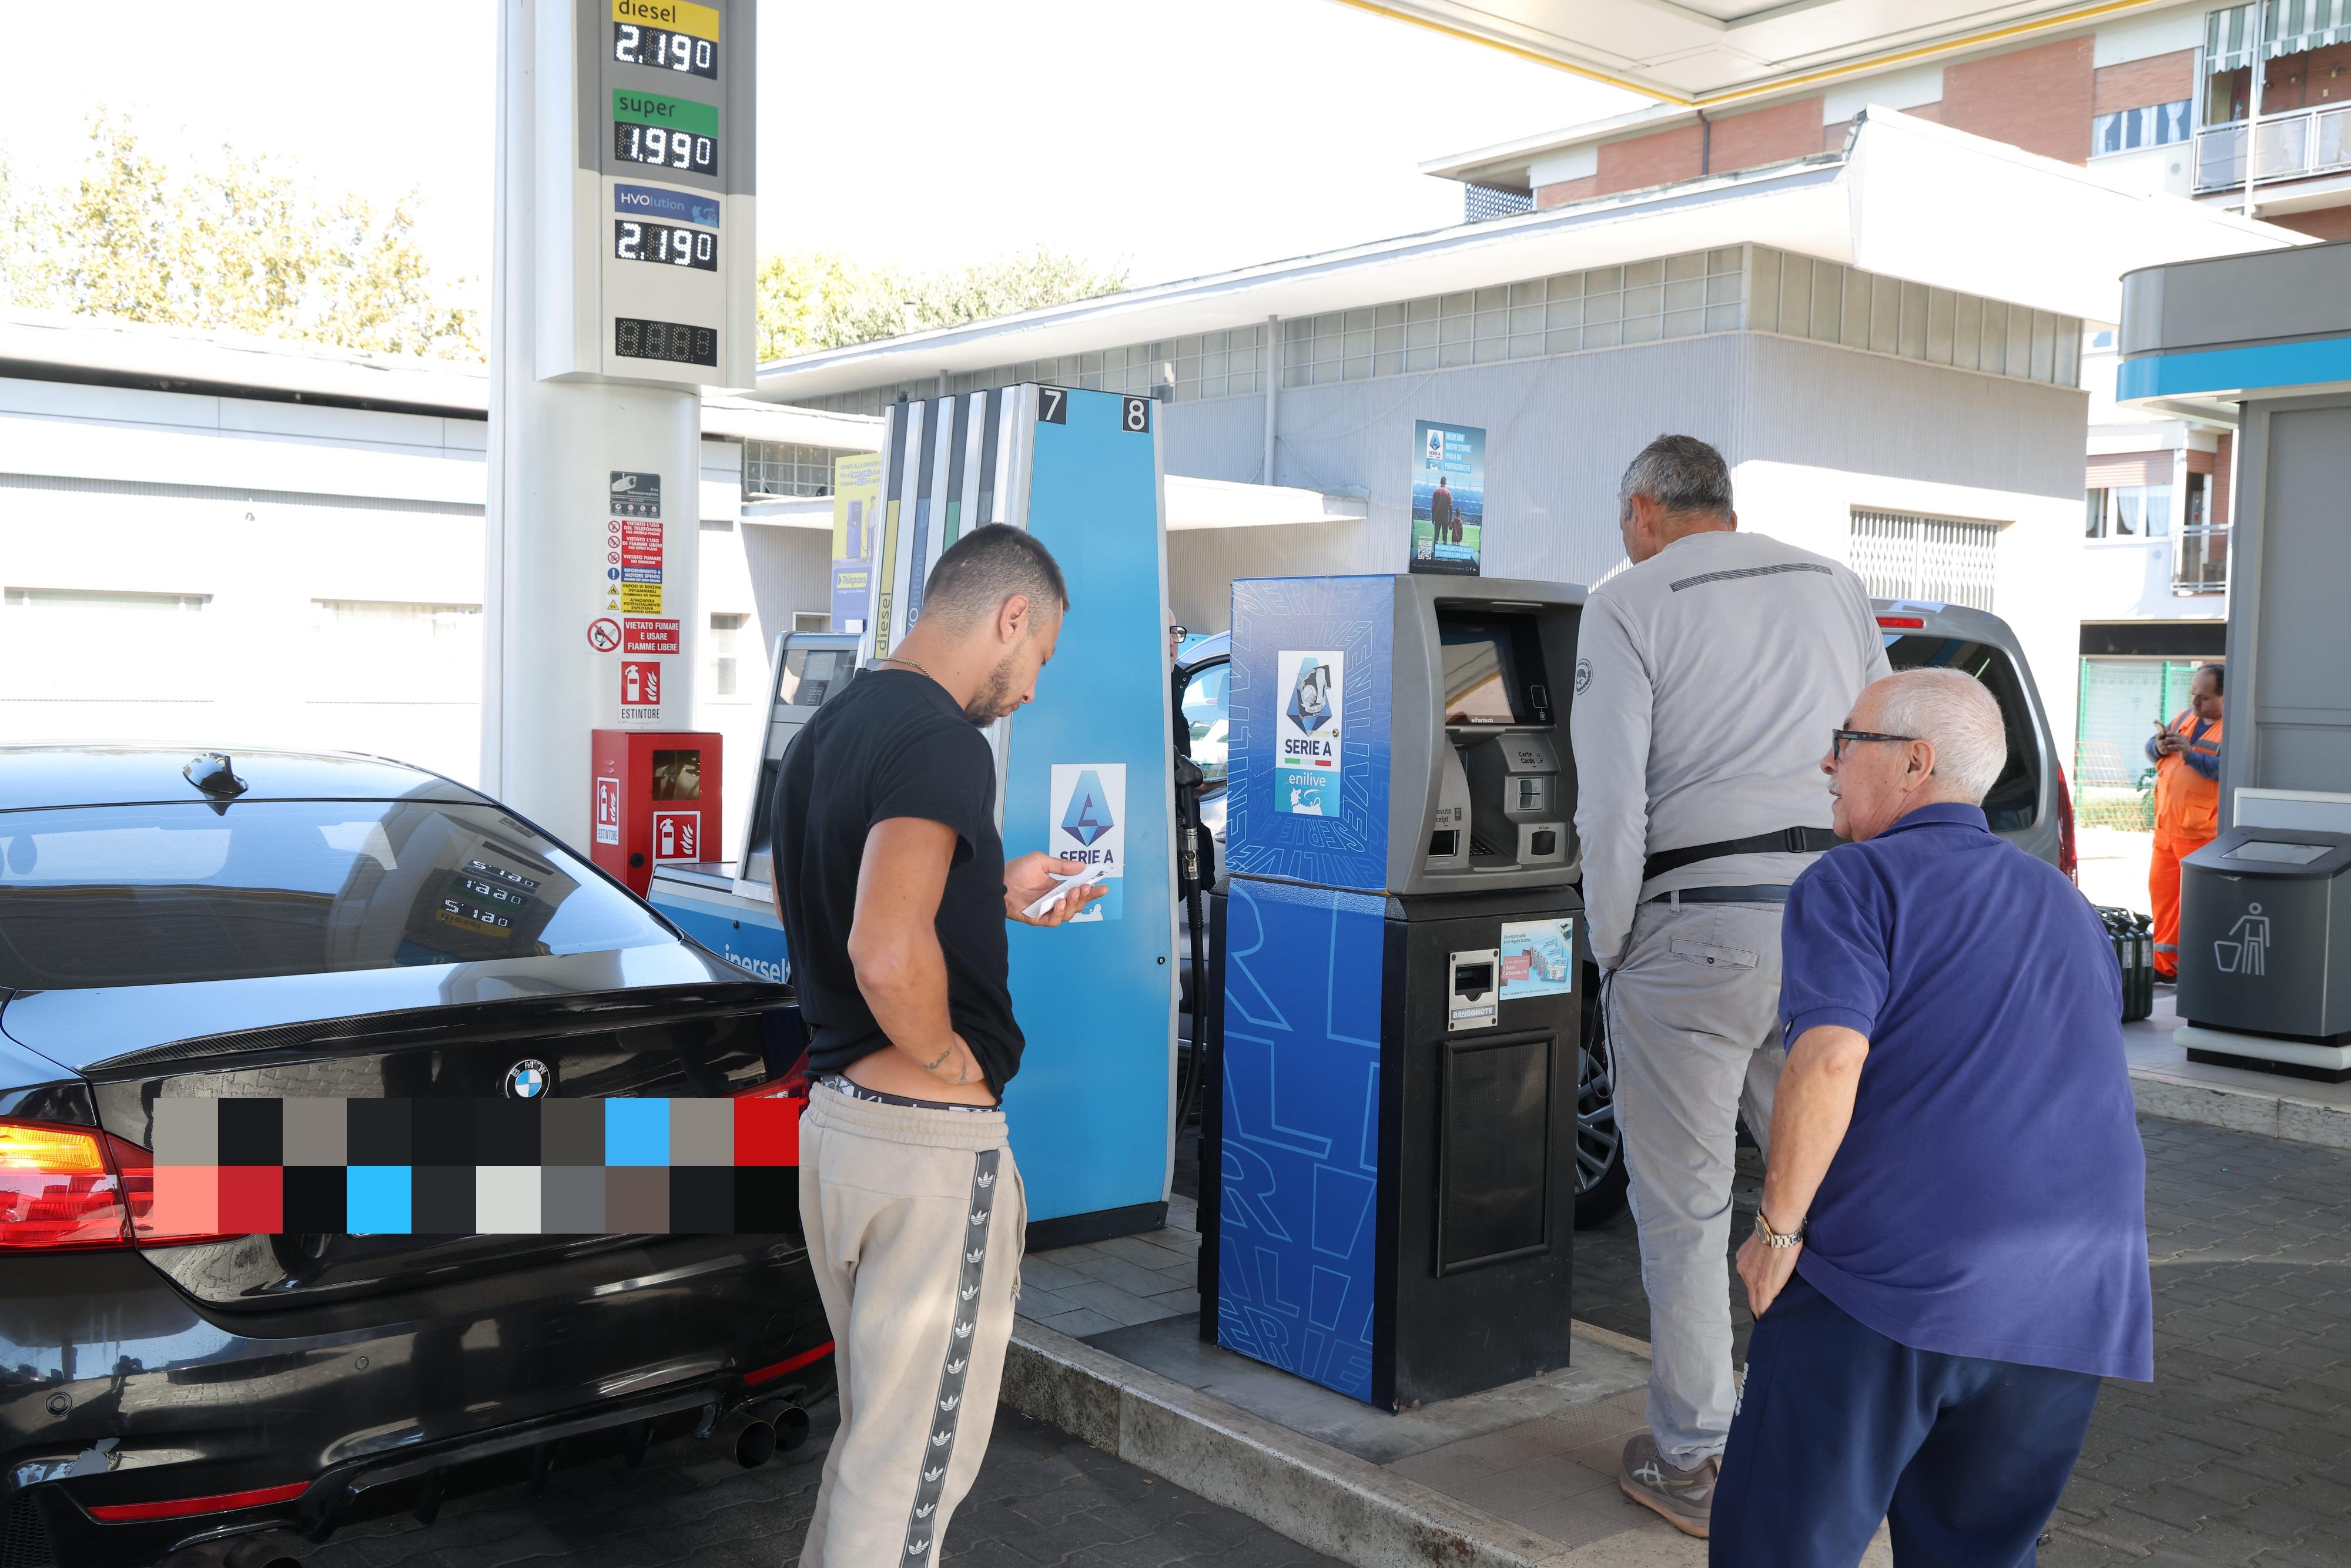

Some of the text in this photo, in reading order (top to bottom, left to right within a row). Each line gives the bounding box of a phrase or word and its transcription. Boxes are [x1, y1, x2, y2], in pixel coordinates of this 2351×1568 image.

[618, 0, 676, 23] diesel
[616, 25, 711, 72] 2.190
[619, 97, 675, 118] super
[631, 128, 711, 169] 1.990
[621, 193, 685, 211] HVOlution
[618, 223, 711, 266] 2.190
[1043, 390, 1062, 421] 7
[1127, 400, 1145, 430] 8
[843, 575, 866, 586] Telepass
[909, 554, 923, 629] Olution
[625, 621, 679, 631] VIETATO FUMARE
[878, 592, 891, 651] diesel
[628, 642, 677, 651] FIAMME LIBERE
[621, 709, 660, 719] ESTINTORE
[1285, 739, 1332, 756] SERIE A
[1288, 772, 1326, 787] enilive
[598, 828, 618, 841] ESTINTORE
[1060, 849, 1114, 865] SERIE A
[1452, 1007, 1493, 1018] BANCONOTE
[510, 1061, 547, 1078] BMW
